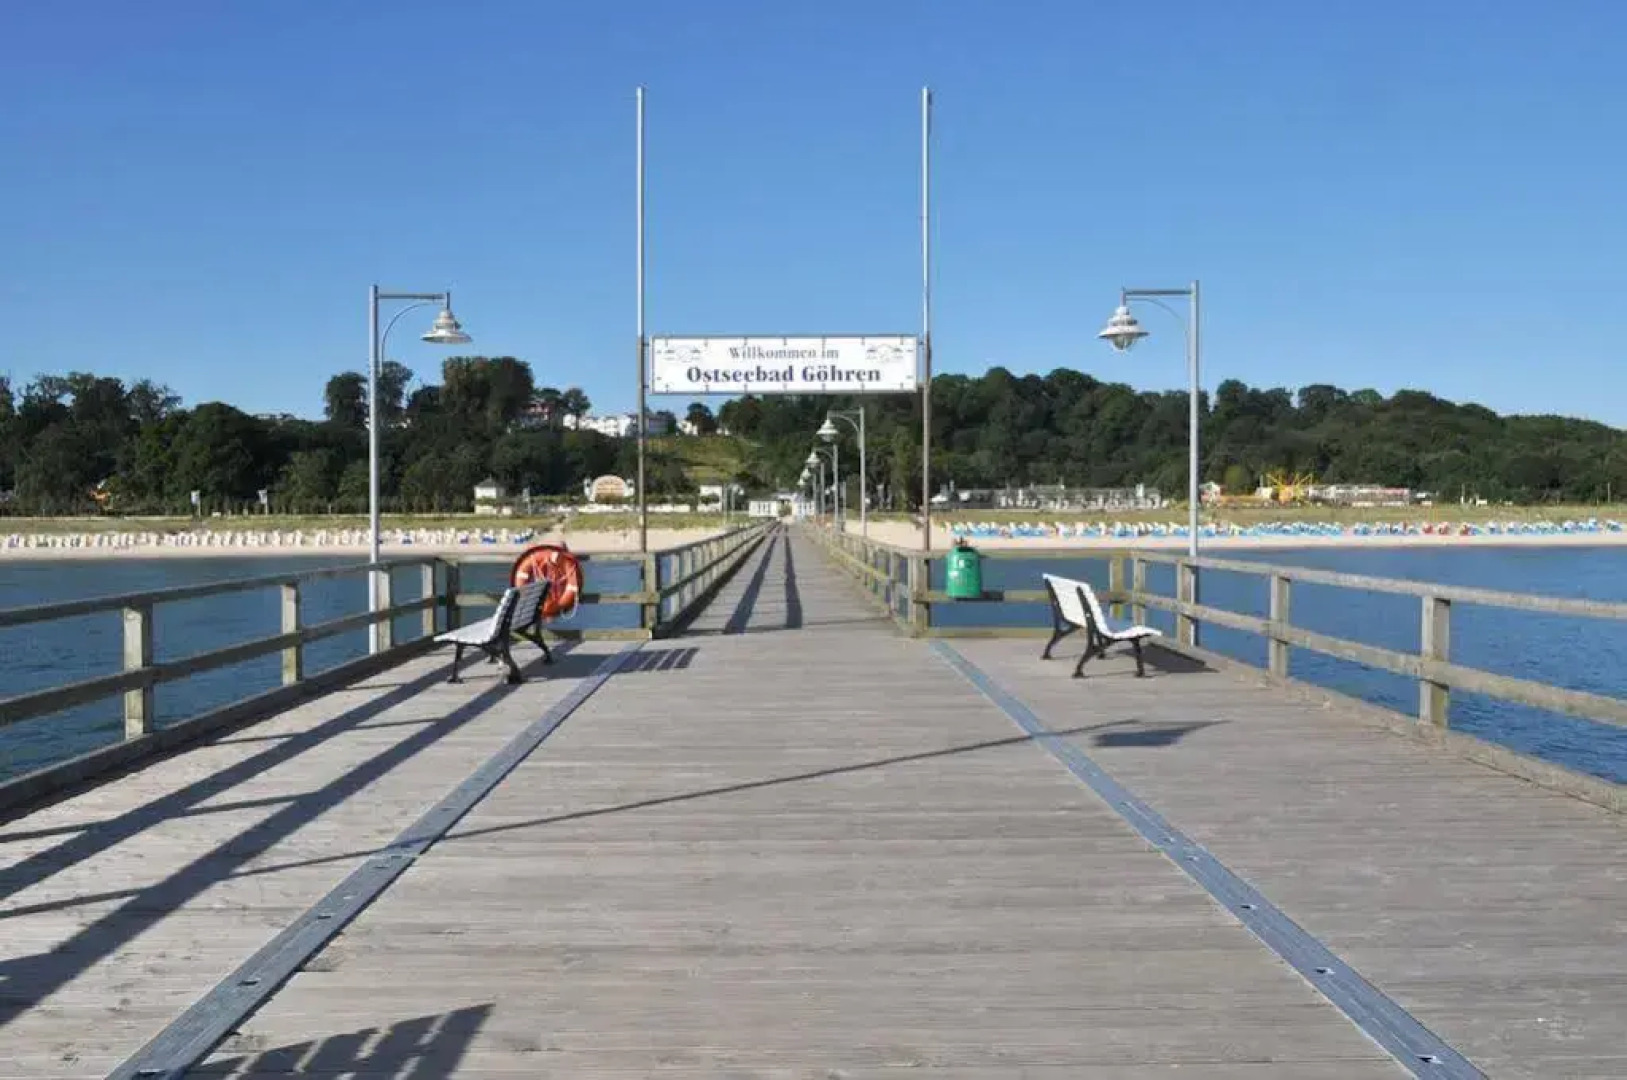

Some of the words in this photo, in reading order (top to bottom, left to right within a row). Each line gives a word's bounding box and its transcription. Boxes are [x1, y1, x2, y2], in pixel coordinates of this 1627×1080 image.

[729, 346, 817, 359] Willkommen
[822, 346, 839, 359] im
[686, 365, 794, 383] Ostseebad
[802, 365, 881, 382] Göhren
